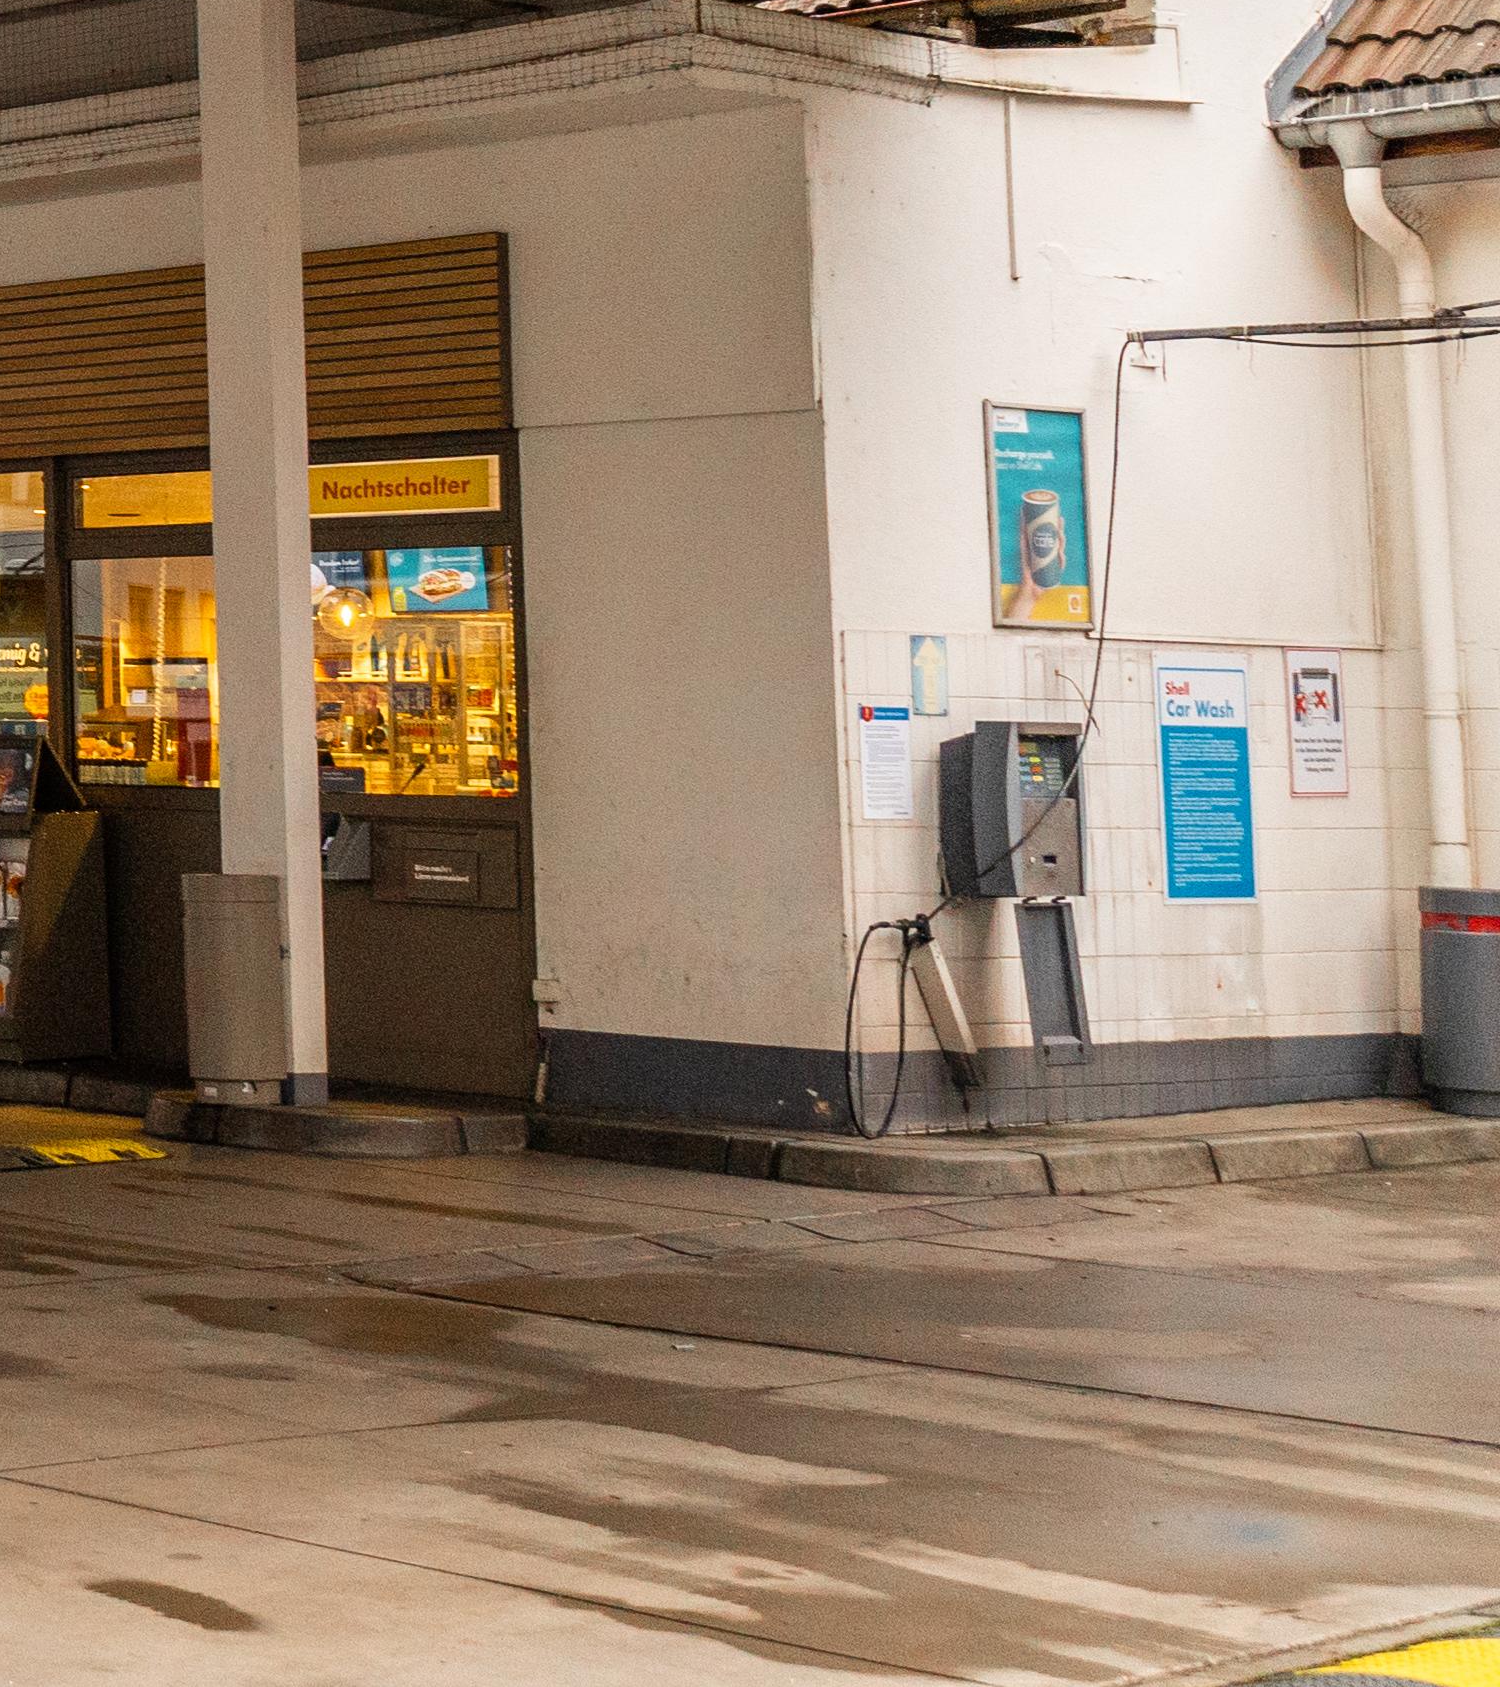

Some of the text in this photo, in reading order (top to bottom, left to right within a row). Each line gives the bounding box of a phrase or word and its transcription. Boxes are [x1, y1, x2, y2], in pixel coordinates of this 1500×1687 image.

[322, 475, 470, 500] Nachtschalter
[1165, 680, 1190, 696] Shell
[1166, 699, 1235, 718] Car Wash
